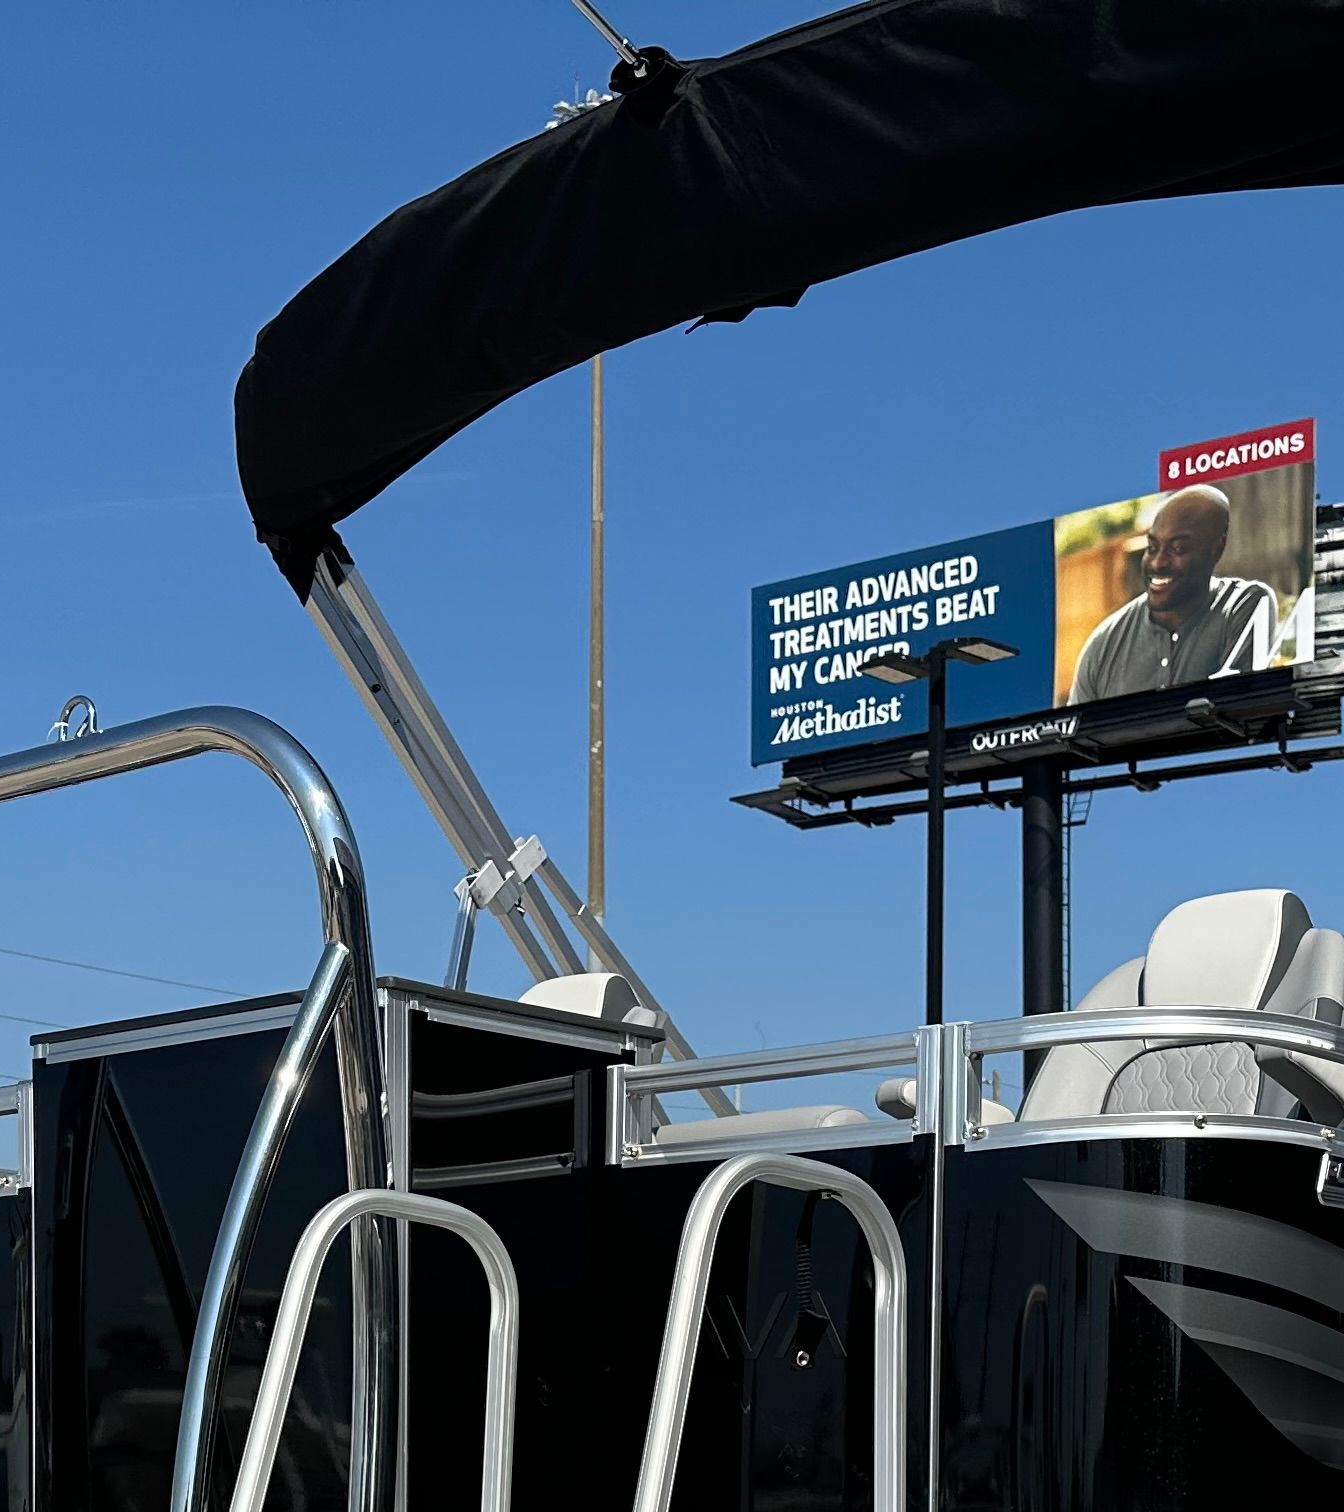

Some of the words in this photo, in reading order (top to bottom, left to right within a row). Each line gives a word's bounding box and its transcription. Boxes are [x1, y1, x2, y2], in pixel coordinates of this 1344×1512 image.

[1168, 461, 1180, 479] 8
[1185, 433, 1305, 475] LOCATIONS
[769, 586, 839, 625] THEIR
[845, 555, 978, 610] ADVANCED
[769, 601, 929, 660] TREATMENTS
[936, 585, 1000, 626] BEAT
[769, 660, 808, 694] MY
[770, 699, 824, 718] HOUSTON
[770, 697, 902, 745] Methodist
